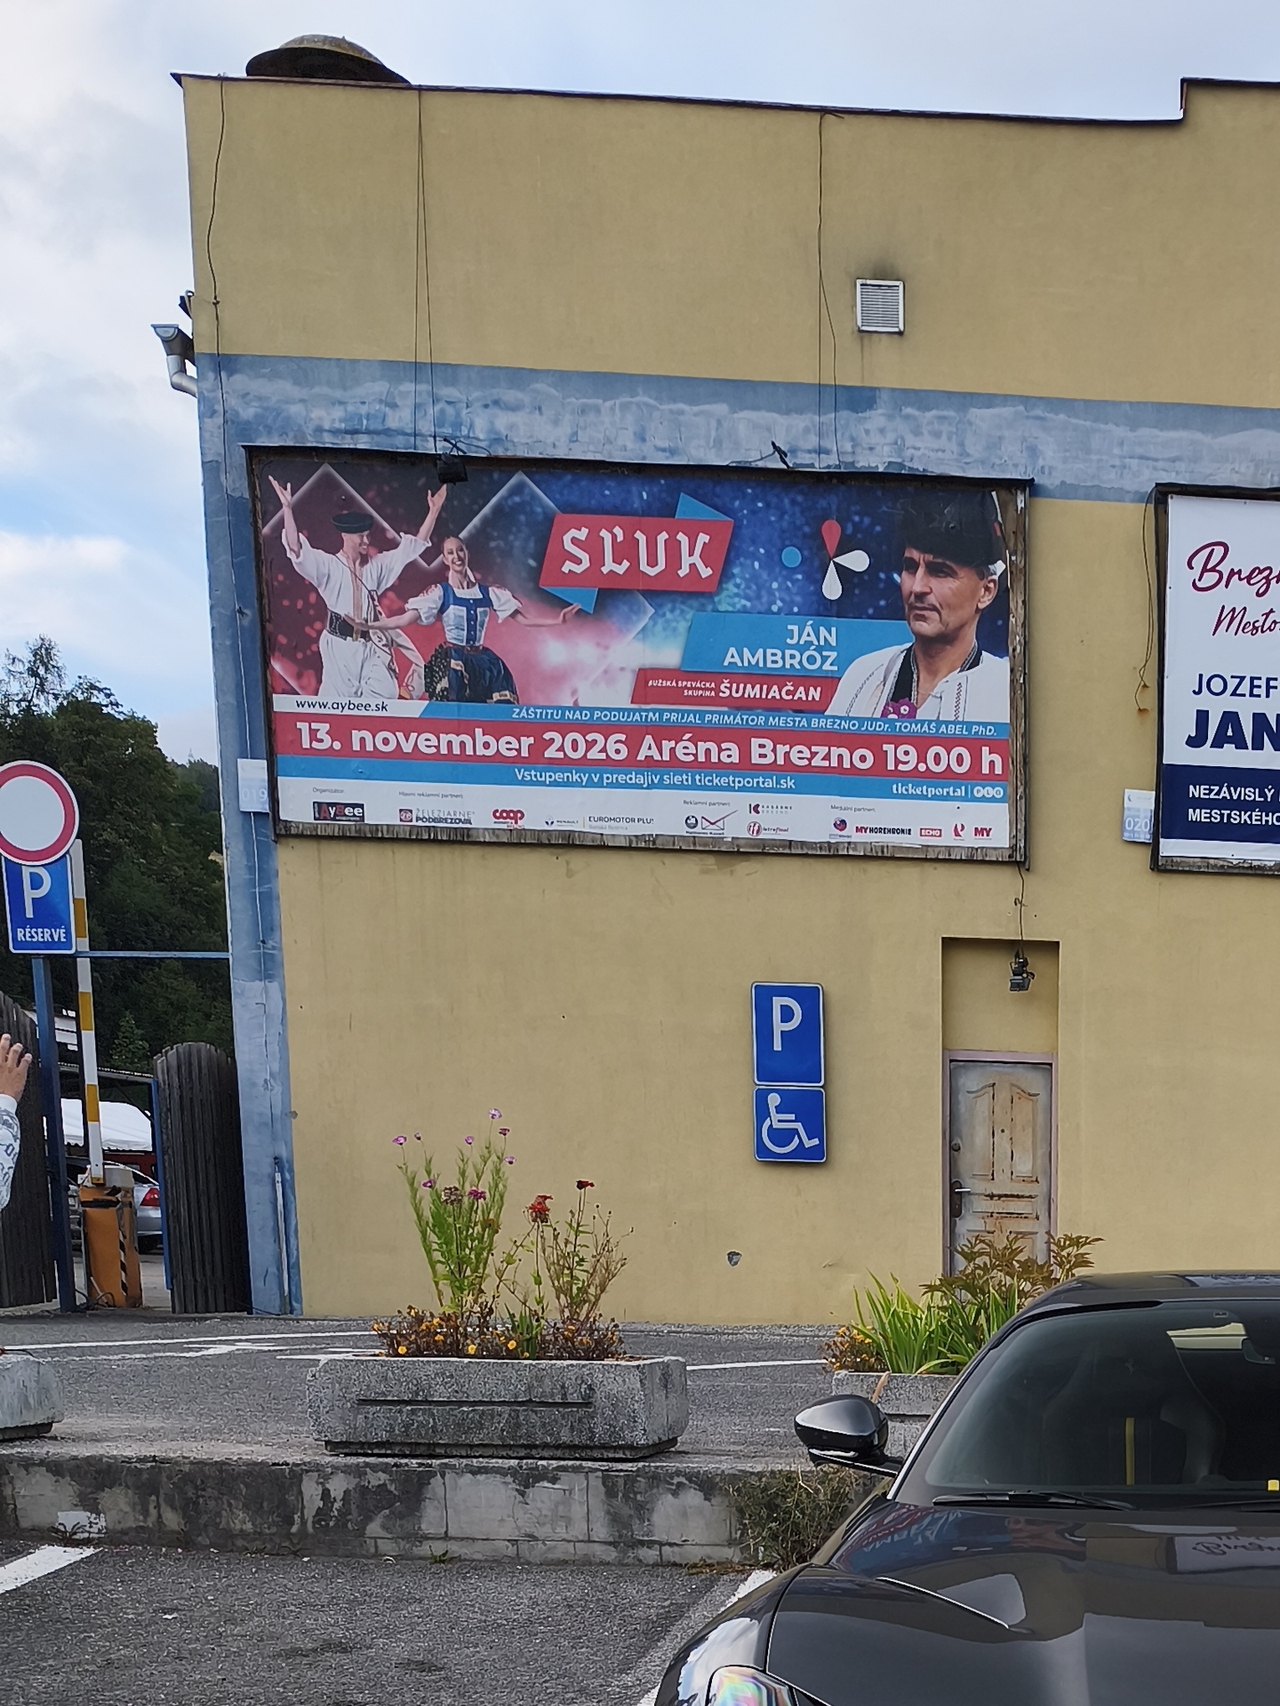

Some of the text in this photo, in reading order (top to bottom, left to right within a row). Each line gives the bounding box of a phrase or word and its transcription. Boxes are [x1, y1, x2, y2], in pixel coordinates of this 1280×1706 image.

[561, 525, 713, 579] SĽUK
[786, 620, 837, 647] JÁN
[723, 645, 838, 671] AMBRÓZ
[677, 680, 716, 689] SPEVÁCKA
[683, 688, 716, 698] SKUPINA
[719, 678, 822, 701] ŠUMIAČAN
[1192, 673, 1279, 699] JOZEF
[296, 699, 389, 713] www.aybee.sk
[512, 707, 562, 719] ZÁŠTITU
[564, 710, 590, 721] NAD
[663, 712, 701, 723] PRIJAL
[704, 713, 765, 726] PRIMÁTOR
[768, 716, 808, 728] MESTA
[811, 718, 859, 730] BREZNO
[861, 721, 891, 732] JUDr.
[895, 722, 936, 734] TOMÁŠ
[939, 725, 968, 735] ABEL
[971, 725, 997, 736] PhD.
[296, 721, 1002, 775] 13. november 2026 Aréna Brezno 19.00 h
[514, 768, 589, 786] Vstupenky
[591, 772, 600, 782] v
[662, 771, 692, 786] sieti
[694, 773, 796, 790] ticketportal.sk
[241, 788, 268, 801] 019
[892, 783, 965, 798] ticketportal
[1188, 782, 1275, 803] NEZÁVISLÝ
[319, 803, 363, 819] AyBee
[588, 816, 635, 824] EUROMOTOR
[973, 827, 992, 837] MY
[1125, 817, 1150, 832] 020
[22, 865, 51, 918] P
[16, 925, 67, 942] RÉSERVÉ
[772, 996, 802, 1051] P
